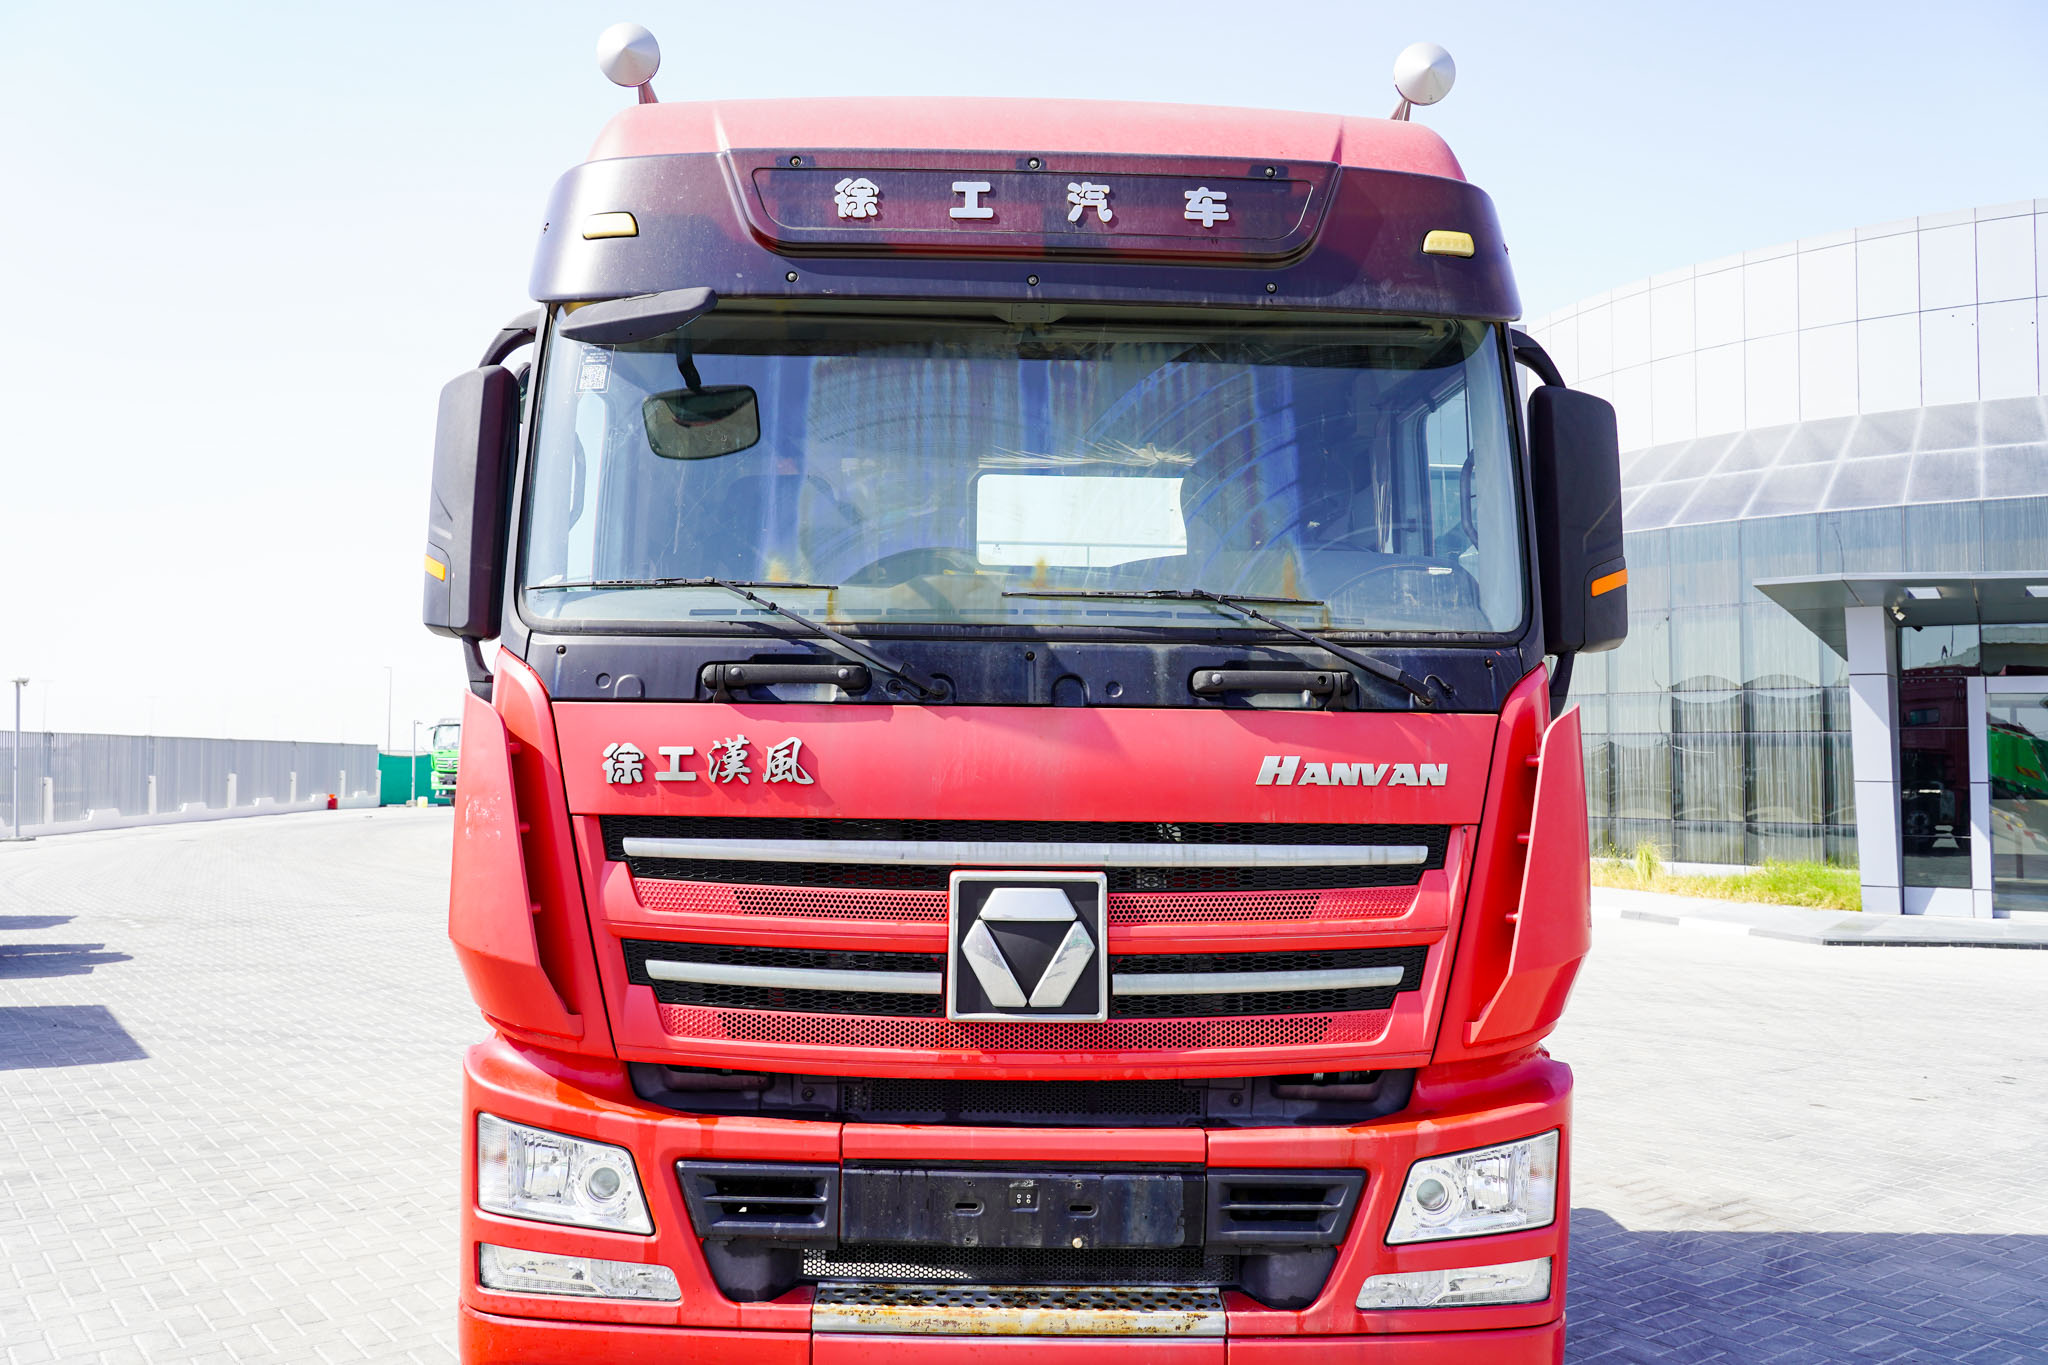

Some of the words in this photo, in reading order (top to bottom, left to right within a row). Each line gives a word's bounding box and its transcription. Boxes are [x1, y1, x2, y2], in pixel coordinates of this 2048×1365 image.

[834, 176, 1230, 229] 徐工汽车
[602, 734, 815, 785] 徐工漢風
[1255, 755, 1449, 787] HANVAN
